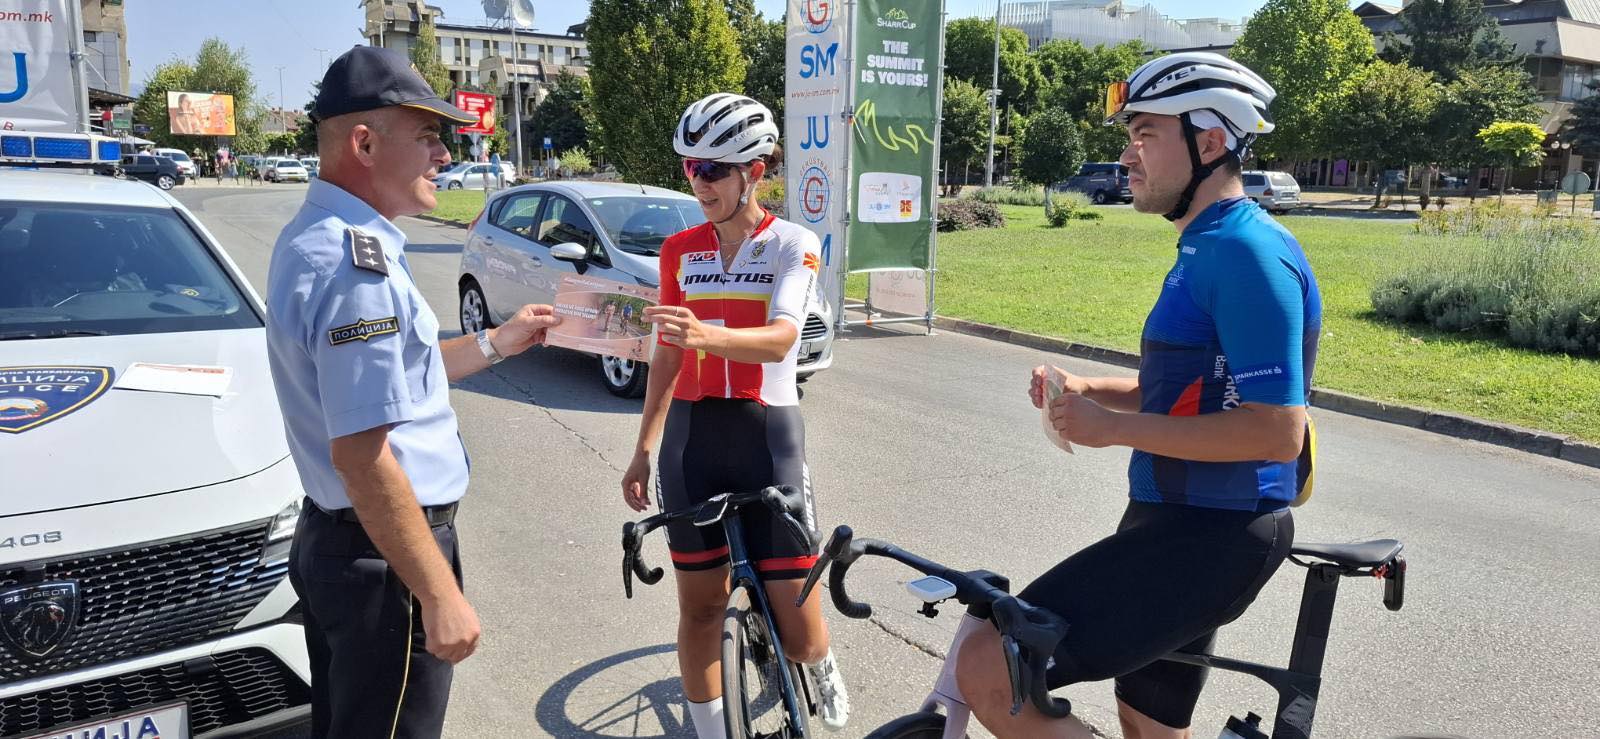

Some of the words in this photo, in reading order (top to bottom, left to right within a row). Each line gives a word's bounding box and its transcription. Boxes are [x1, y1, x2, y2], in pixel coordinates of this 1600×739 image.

[883, 40, 908, 55] THE
[800, 43, 839, 79] SM
[867, 54, 925, 72] SUMMIT
[861, 70, 875, 83] IS
[877, 71, 929, 88] YOURS!
[800, 115, 829, 150] JU
[684, 272, 775, 286] INVICTUS
[335, 322, 393, 340] ПОЛИЦИЈА
[1214, 355, 1227, 378] Bank
[0, 531, 61, 548] 408
[5, 588, 69, 604] PEUGEOT
